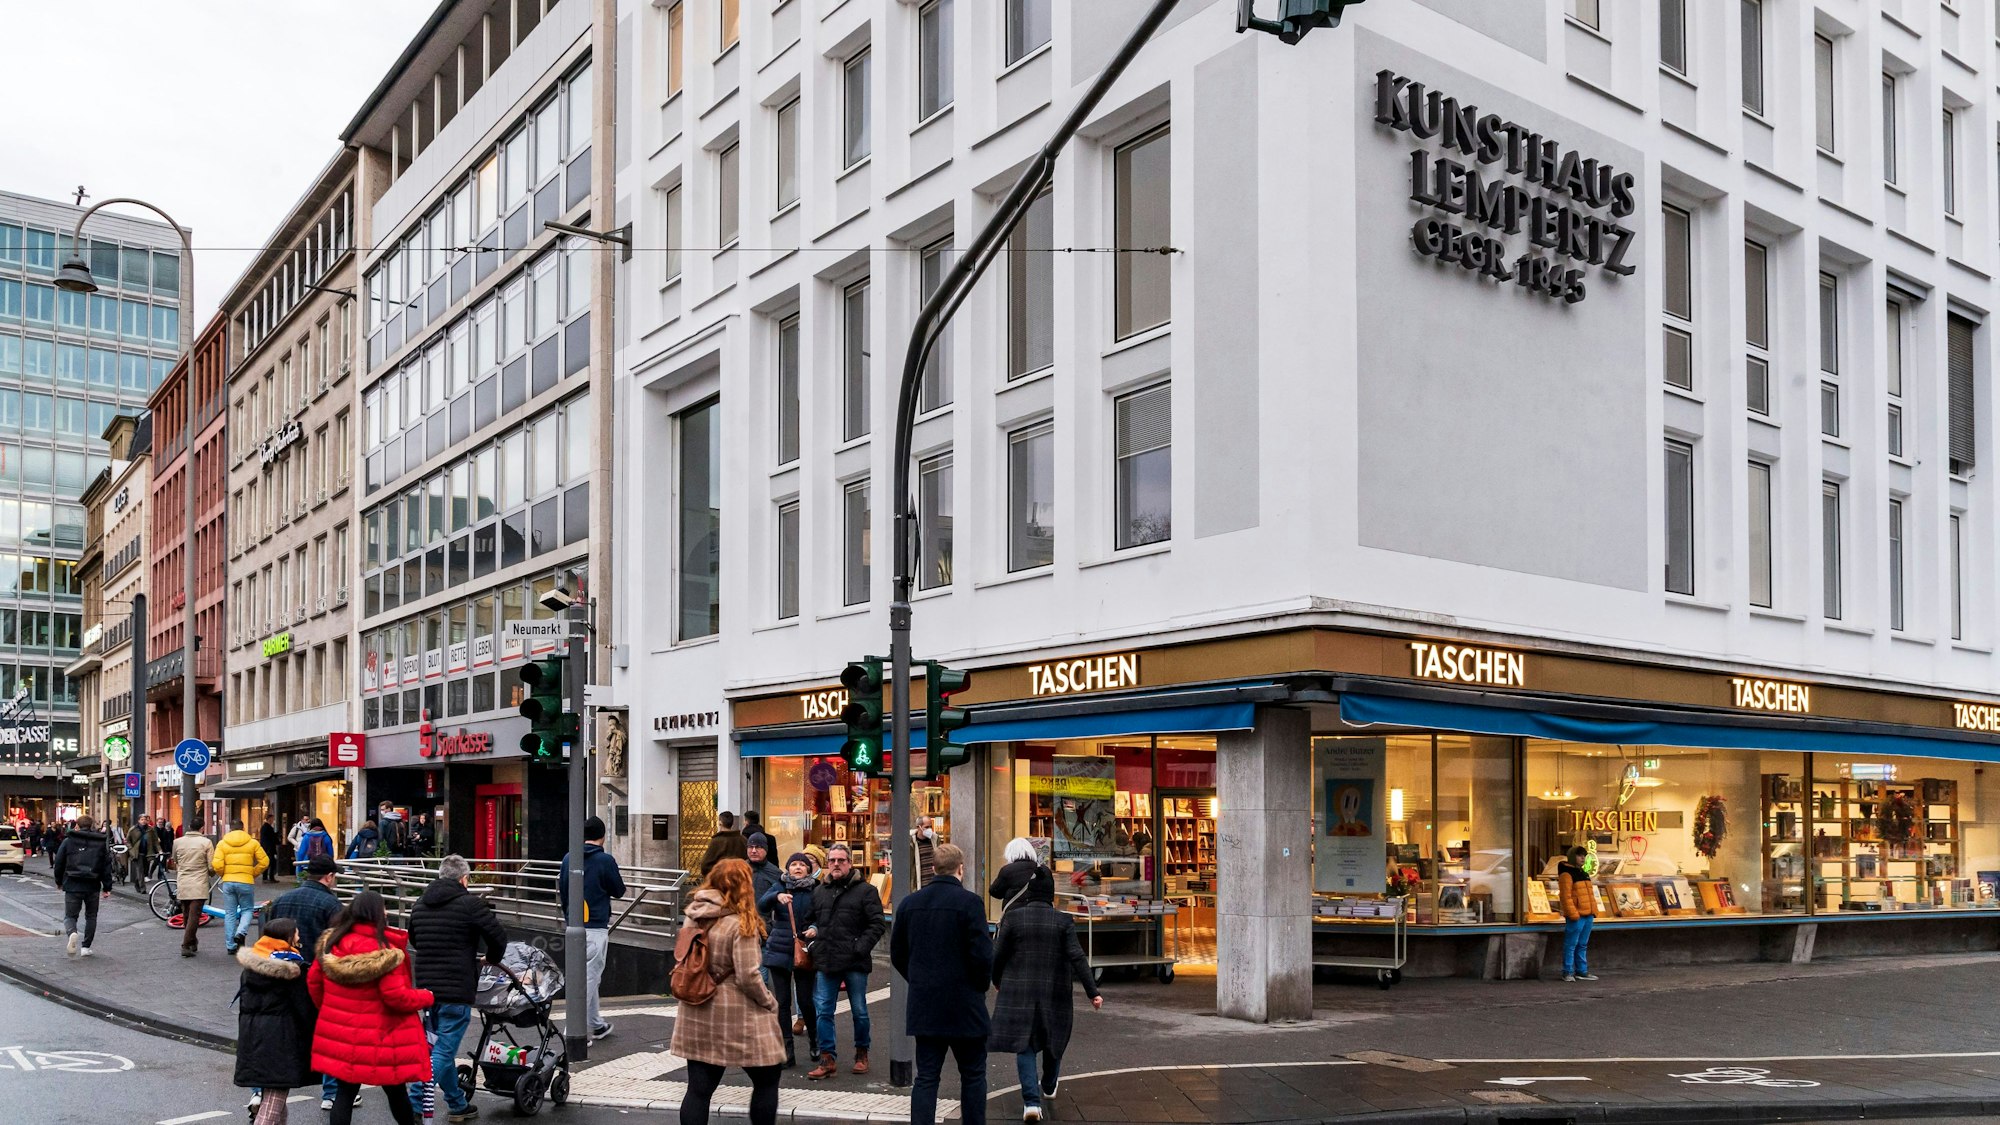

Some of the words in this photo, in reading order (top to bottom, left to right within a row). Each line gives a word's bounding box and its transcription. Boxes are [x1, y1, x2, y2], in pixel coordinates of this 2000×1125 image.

[1375, 69, 1635, 218] KUNSTHAUS
[1409, 149, 1636, 276] LEMPERTZ
[1515, 253, 1587, 304] 1845
[262, 632, 290, 657] BARMER
[513, 623, 561, 635] Neumarkt
[450, 646, 466, 662] RETTE
[1411, 642, 1524, 687] TASCHEN
[1028, 654, 1138, 696] TASCHEN
[1732, 678, 1809, 713] TASCHEN
[435, 730, 490, 761] Sparkasse
[1571, 810, 1657, 832] TASCHEN
